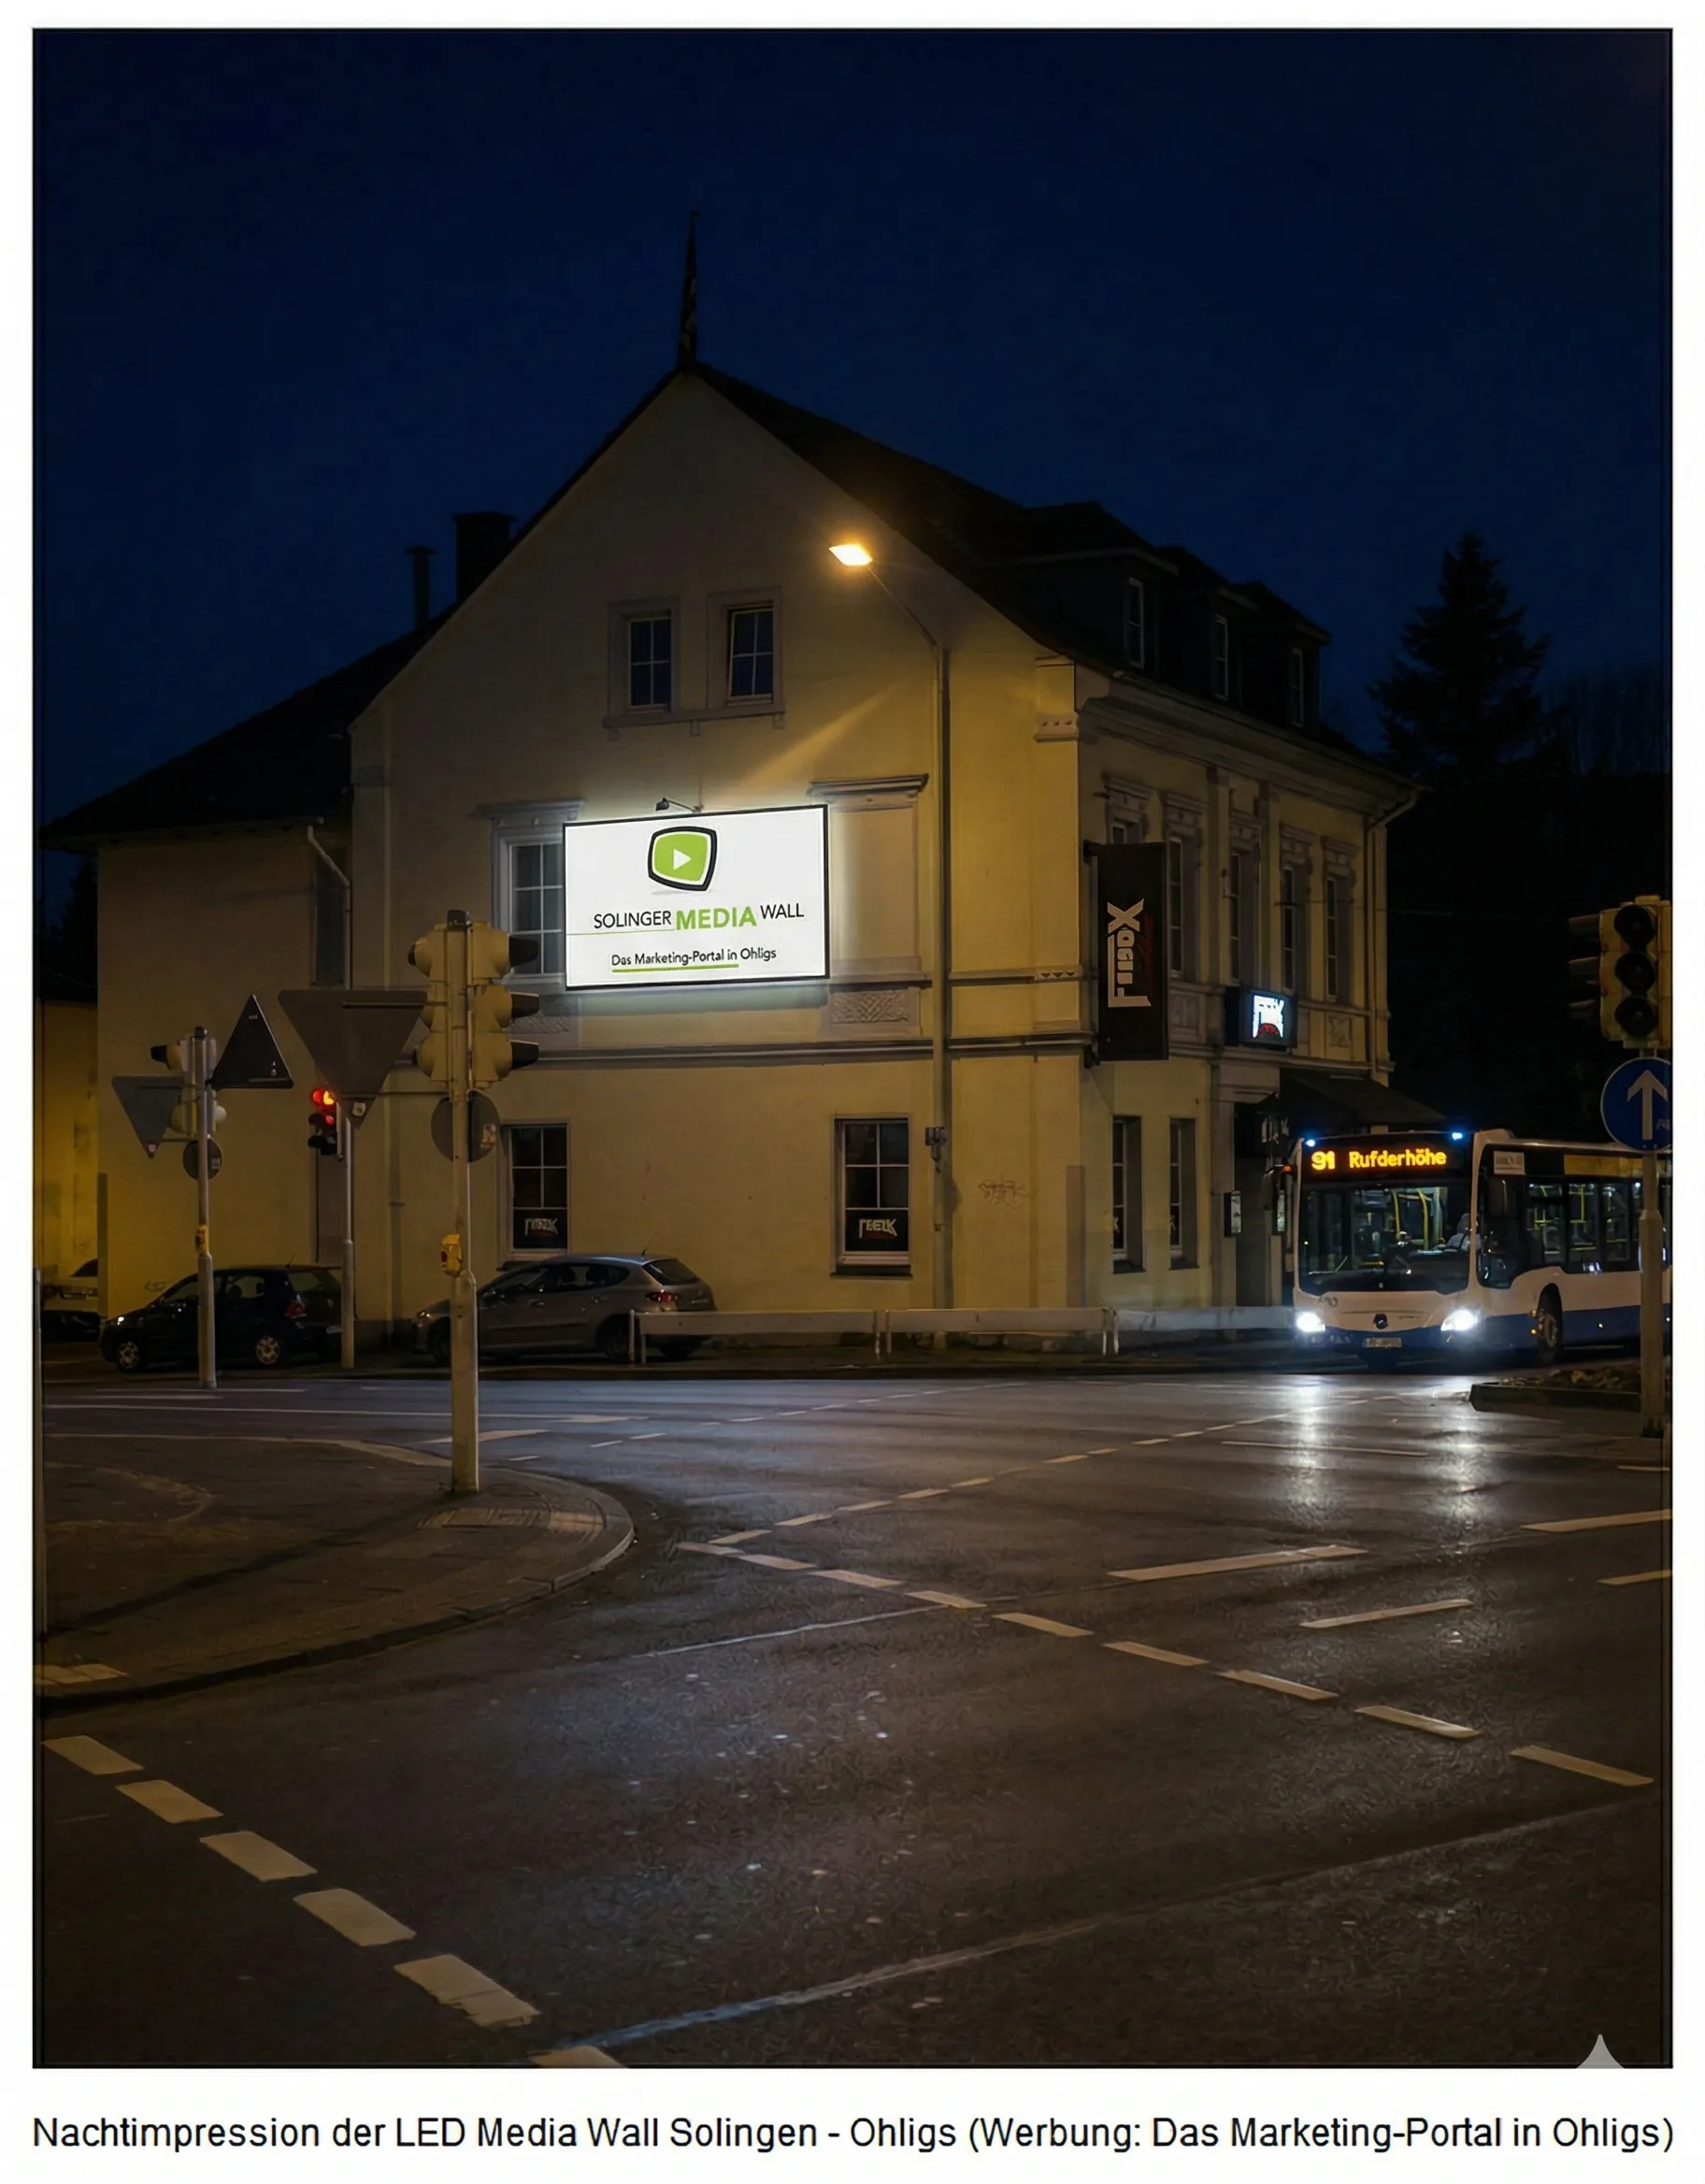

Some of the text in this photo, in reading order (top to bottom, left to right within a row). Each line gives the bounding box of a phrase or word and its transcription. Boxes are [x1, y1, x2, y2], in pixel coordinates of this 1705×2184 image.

[594, 902, 805, 930] SOLINGER MEDIA WALL
[611, 946, 777, 966] Das Marketing-Portal in Ohligs
[1311, 1147, 1447, 1171] 91 Rufderhöhe
